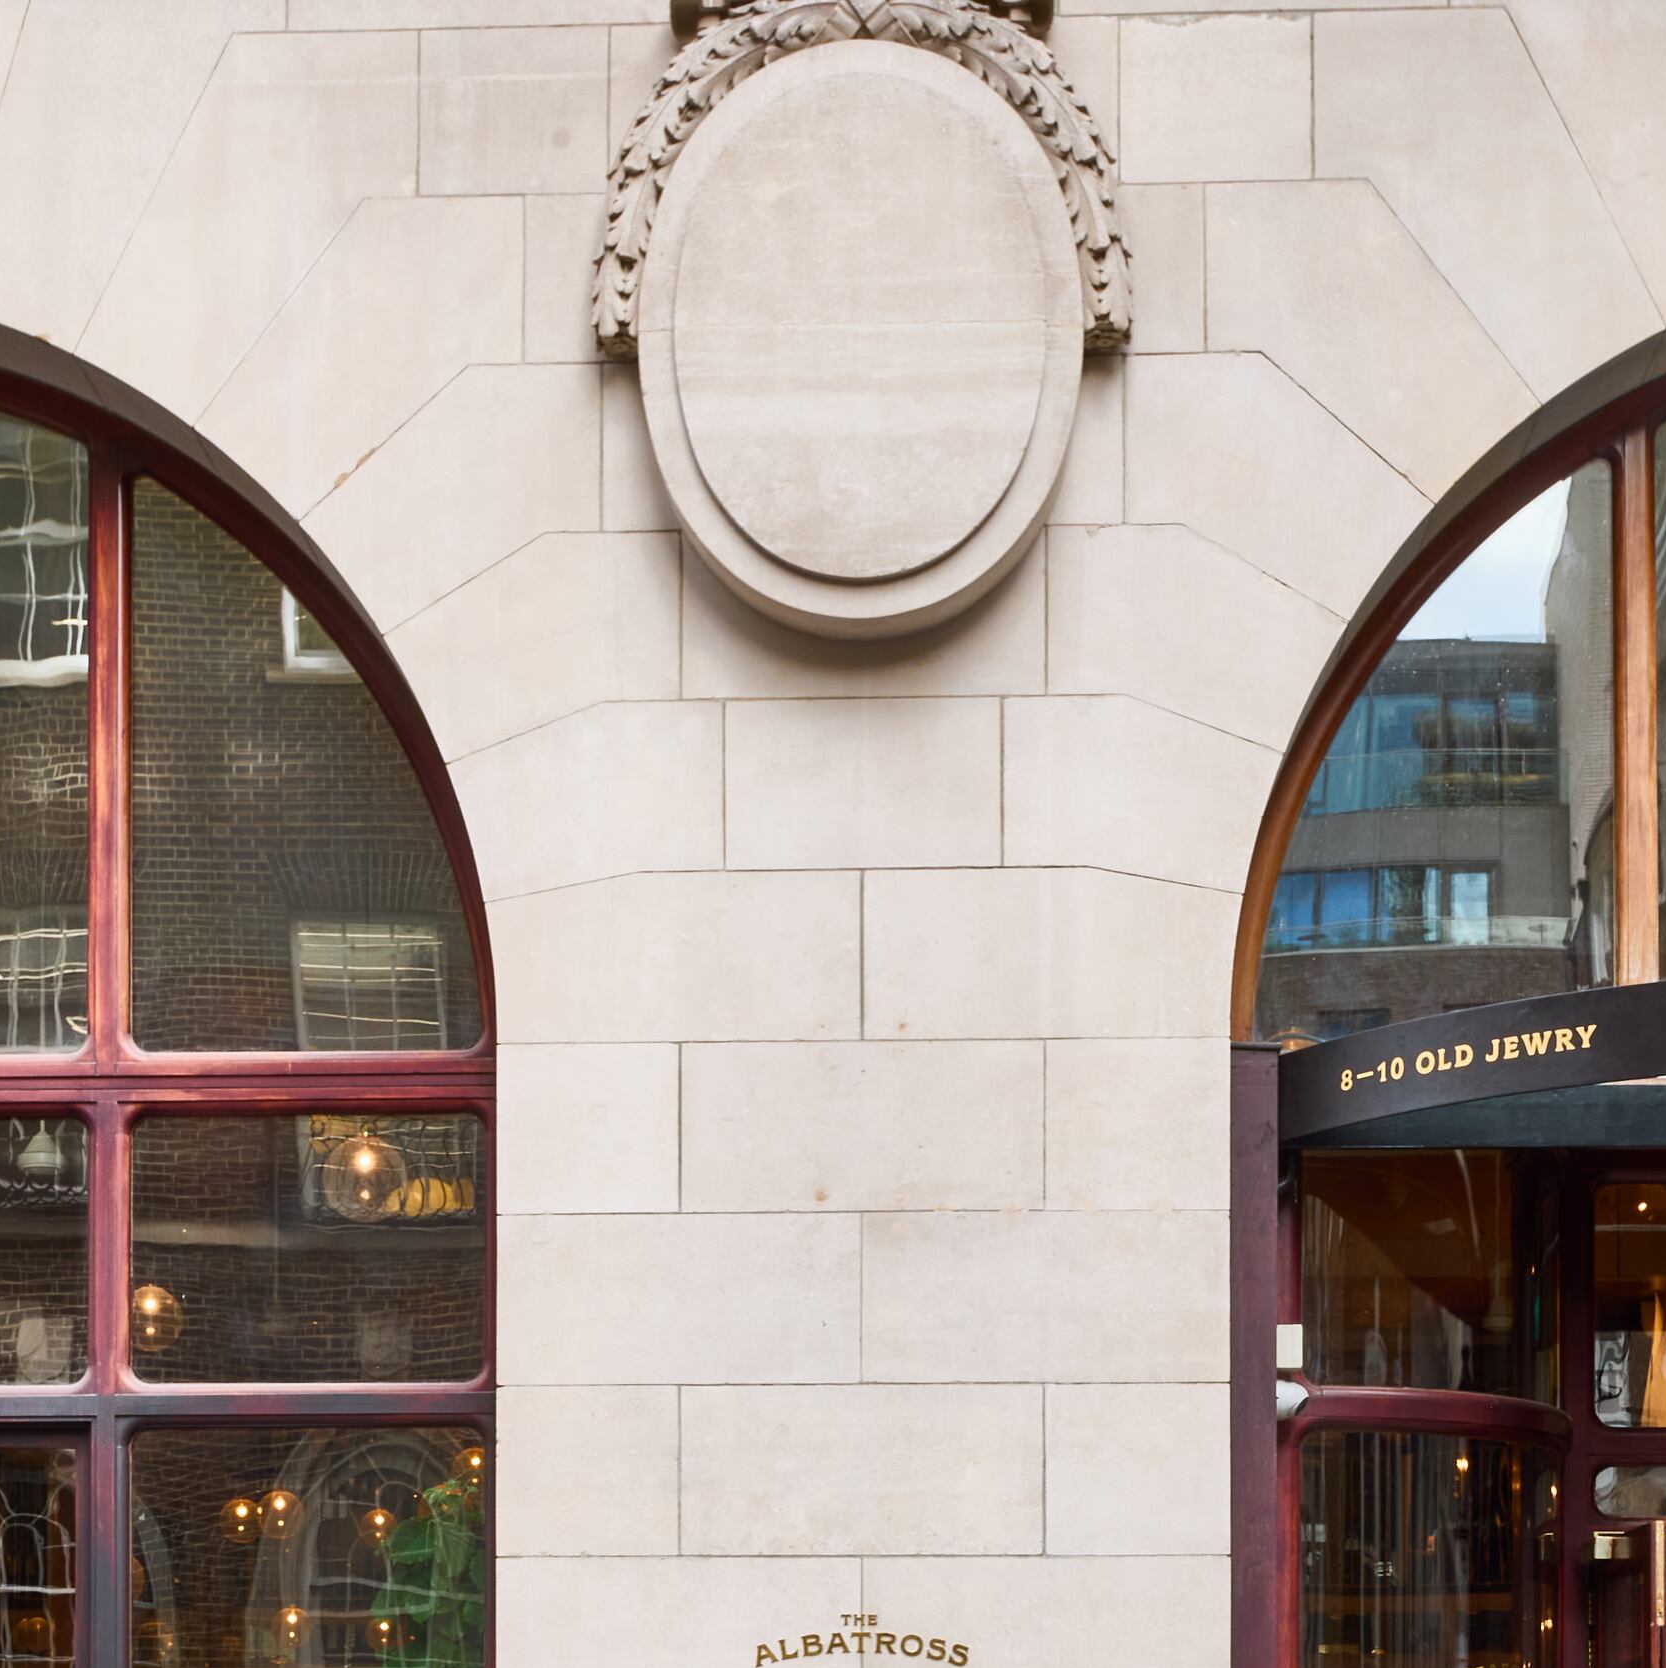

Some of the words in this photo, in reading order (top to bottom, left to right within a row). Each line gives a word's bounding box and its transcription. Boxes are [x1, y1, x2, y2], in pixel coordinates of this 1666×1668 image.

[1415, 1044, 1474, 1075] OLD
[1485, 1024, 1597, 1063] JEWRY
[840, 1614, 878, 1626] THE
[754, 1632, 969, 1668] ALBATROSS
